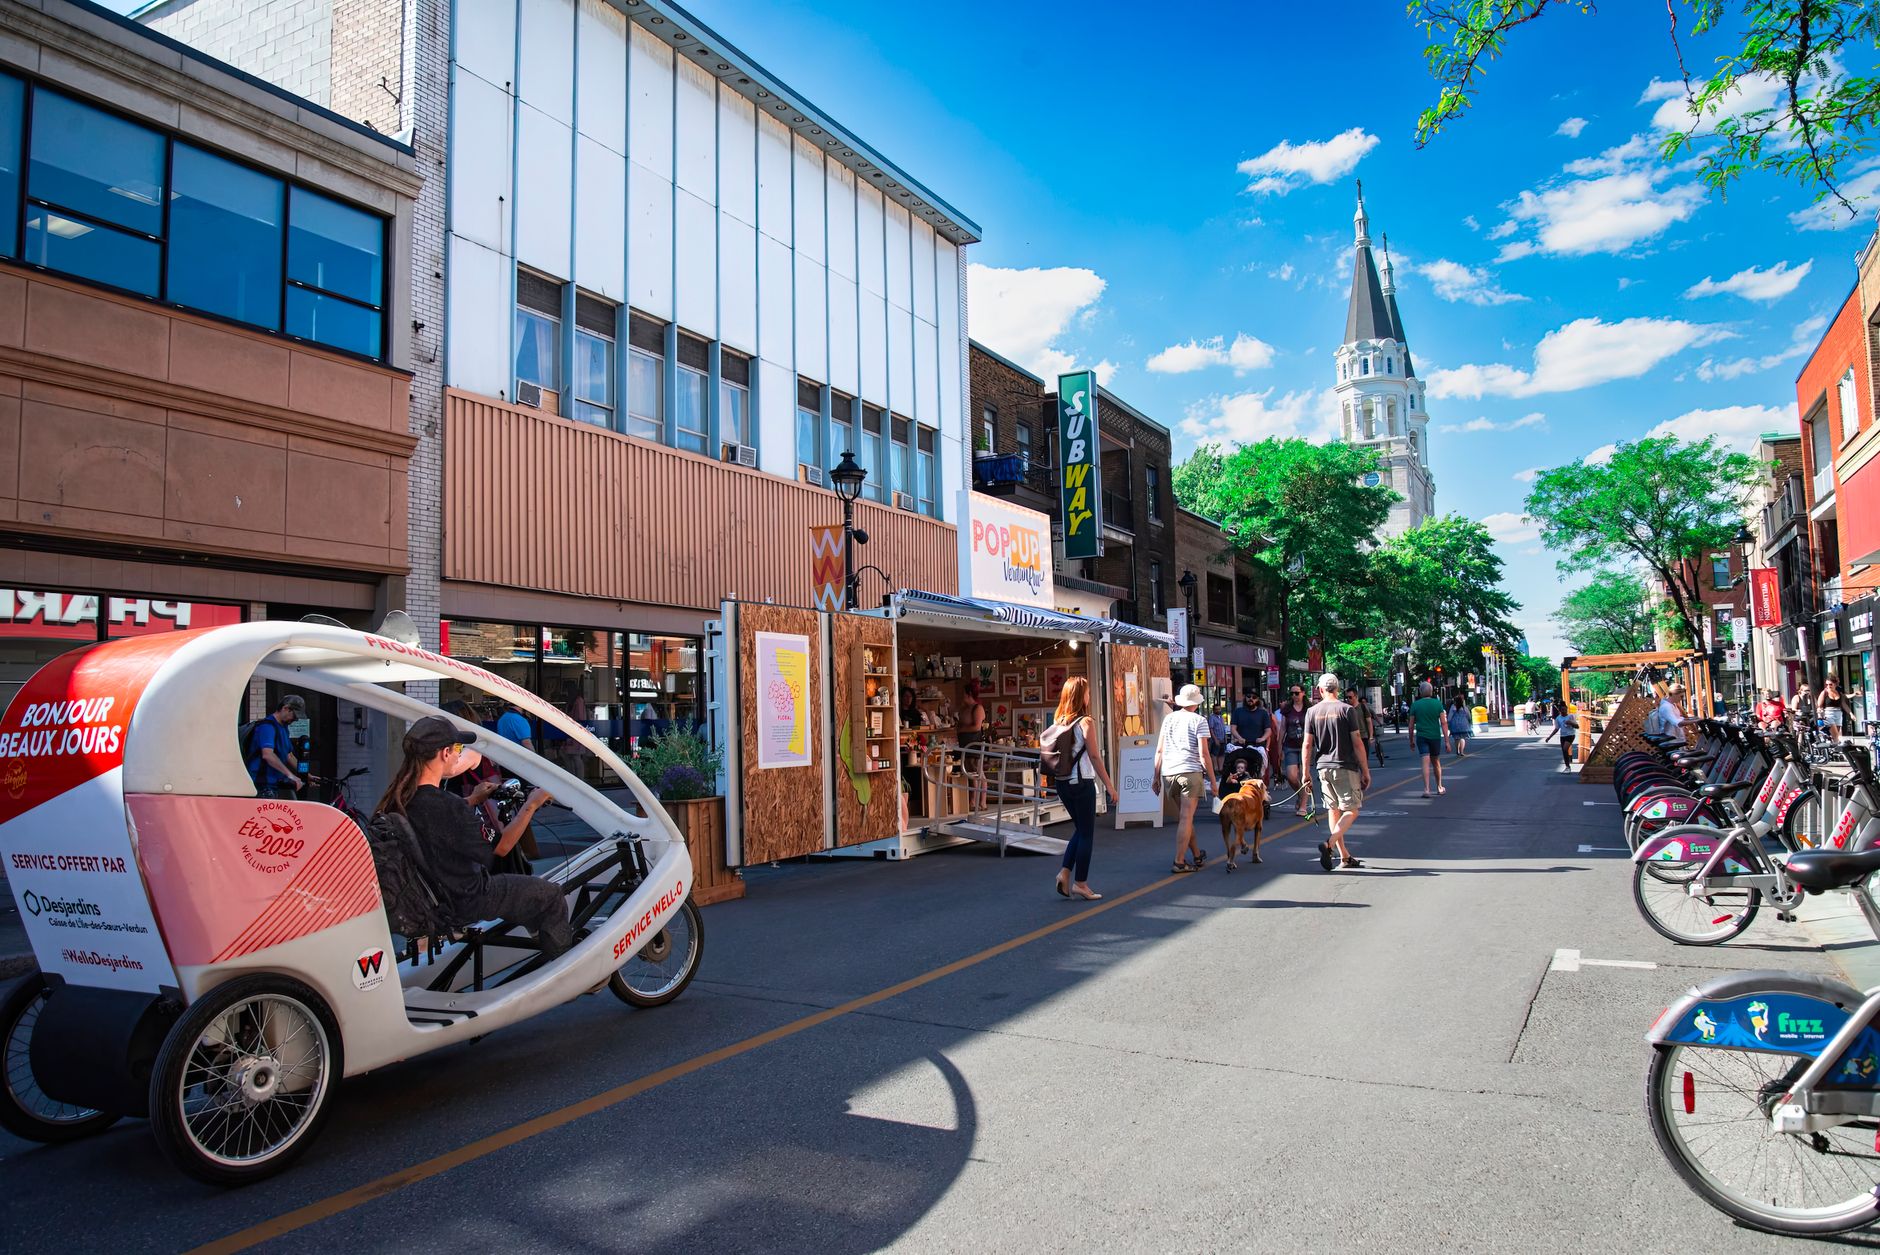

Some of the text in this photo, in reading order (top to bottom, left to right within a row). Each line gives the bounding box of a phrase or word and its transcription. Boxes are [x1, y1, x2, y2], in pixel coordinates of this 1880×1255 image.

[1064, 390, 1093, 536] SUBWAY
[20, 696, 115, 728] BONJOUR
[0, 725, 122, 758] BEAUX JOURS
[238, 816, 268, 839] Été
[257, 802, 304, 832] PROMENADE
[241, 844, 291, 874] WELLINGTON
[255, 834, 305, 859] 2022
[11, 853, 127, 874] SERVICE OFFERT PAR
[40, 895, 101, 917] Desjardins
[48, 917, 68, 928] Caisse
[68, 918, 76, 928] de
[613, 880, 683, 960] SERVICE WELL-O
[61, 948, 144, 973] #WelloDesjardins
[1778, 1012, 1824, 1033] fizz
